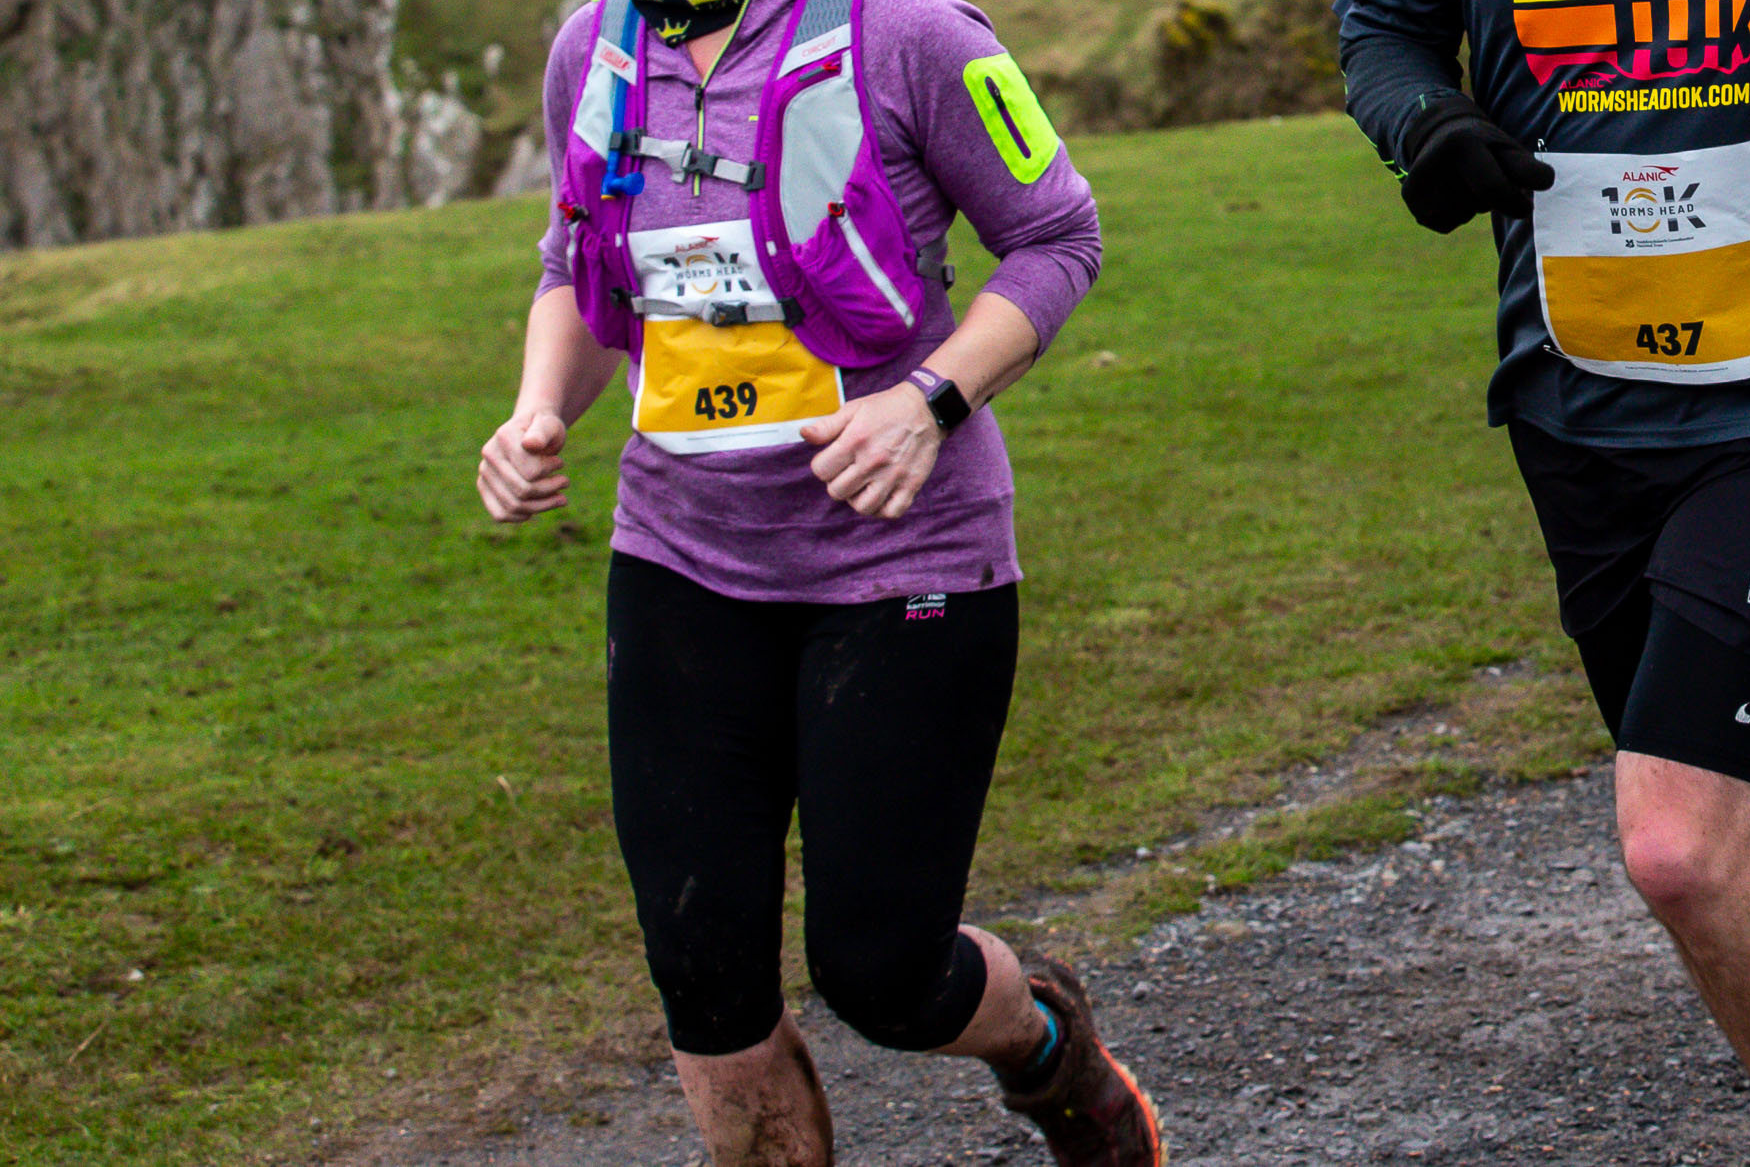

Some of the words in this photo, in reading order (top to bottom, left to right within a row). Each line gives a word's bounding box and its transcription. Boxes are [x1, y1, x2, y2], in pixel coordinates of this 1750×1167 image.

[1558, 75, 1608, 90] ALANIC
[1622, 171, 1668, 183] ALANIC
[1610, 207, 1654, 217] WORMS
[1659, 203, 1694, 216] HEAD
[1636, 320, 1704, 356] 437
[694, 381, 758, 421] 439
[905, 608, 944, 621] RUN
